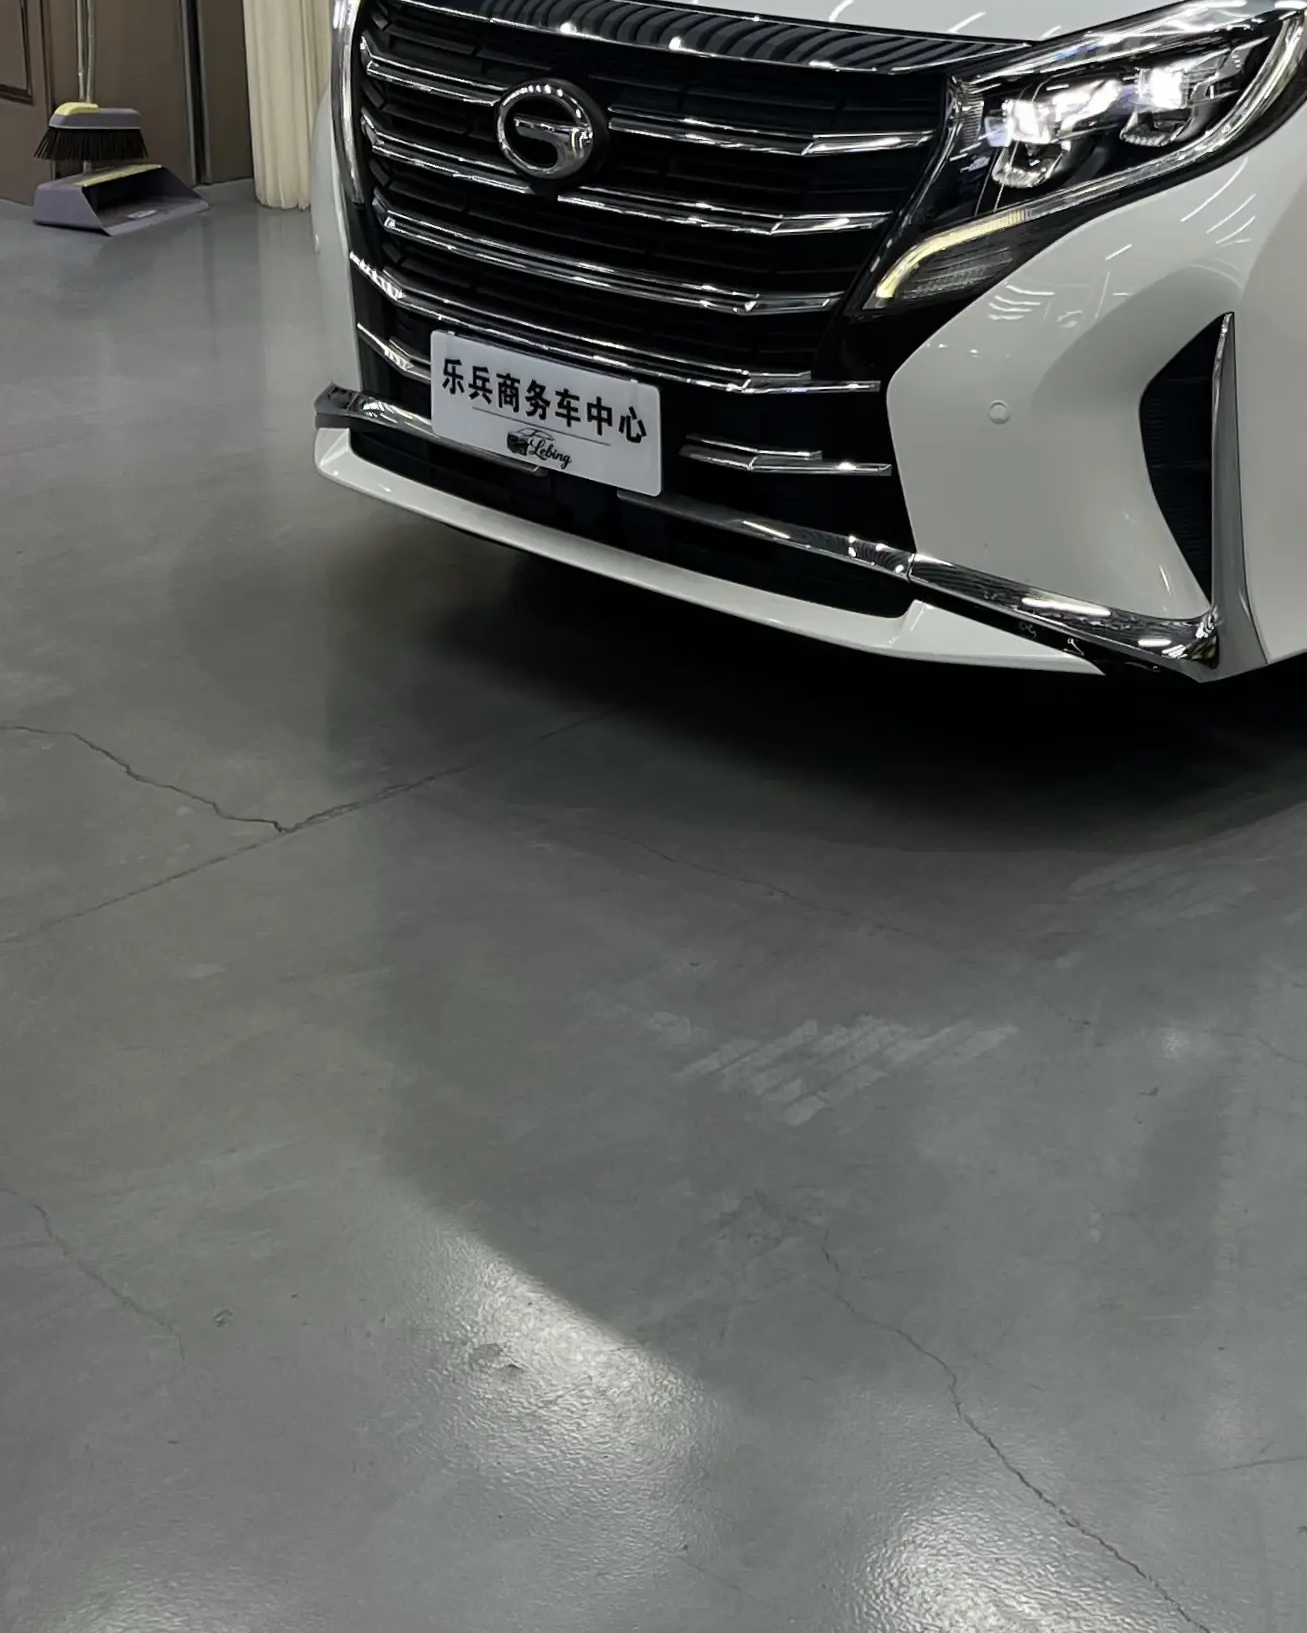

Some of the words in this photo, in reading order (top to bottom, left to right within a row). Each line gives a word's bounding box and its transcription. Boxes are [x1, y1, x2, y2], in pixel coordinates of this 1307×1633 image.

[441, 357, 648, 444] 乐兵商务车中心
[528, 438, 573, 470] Lebing
